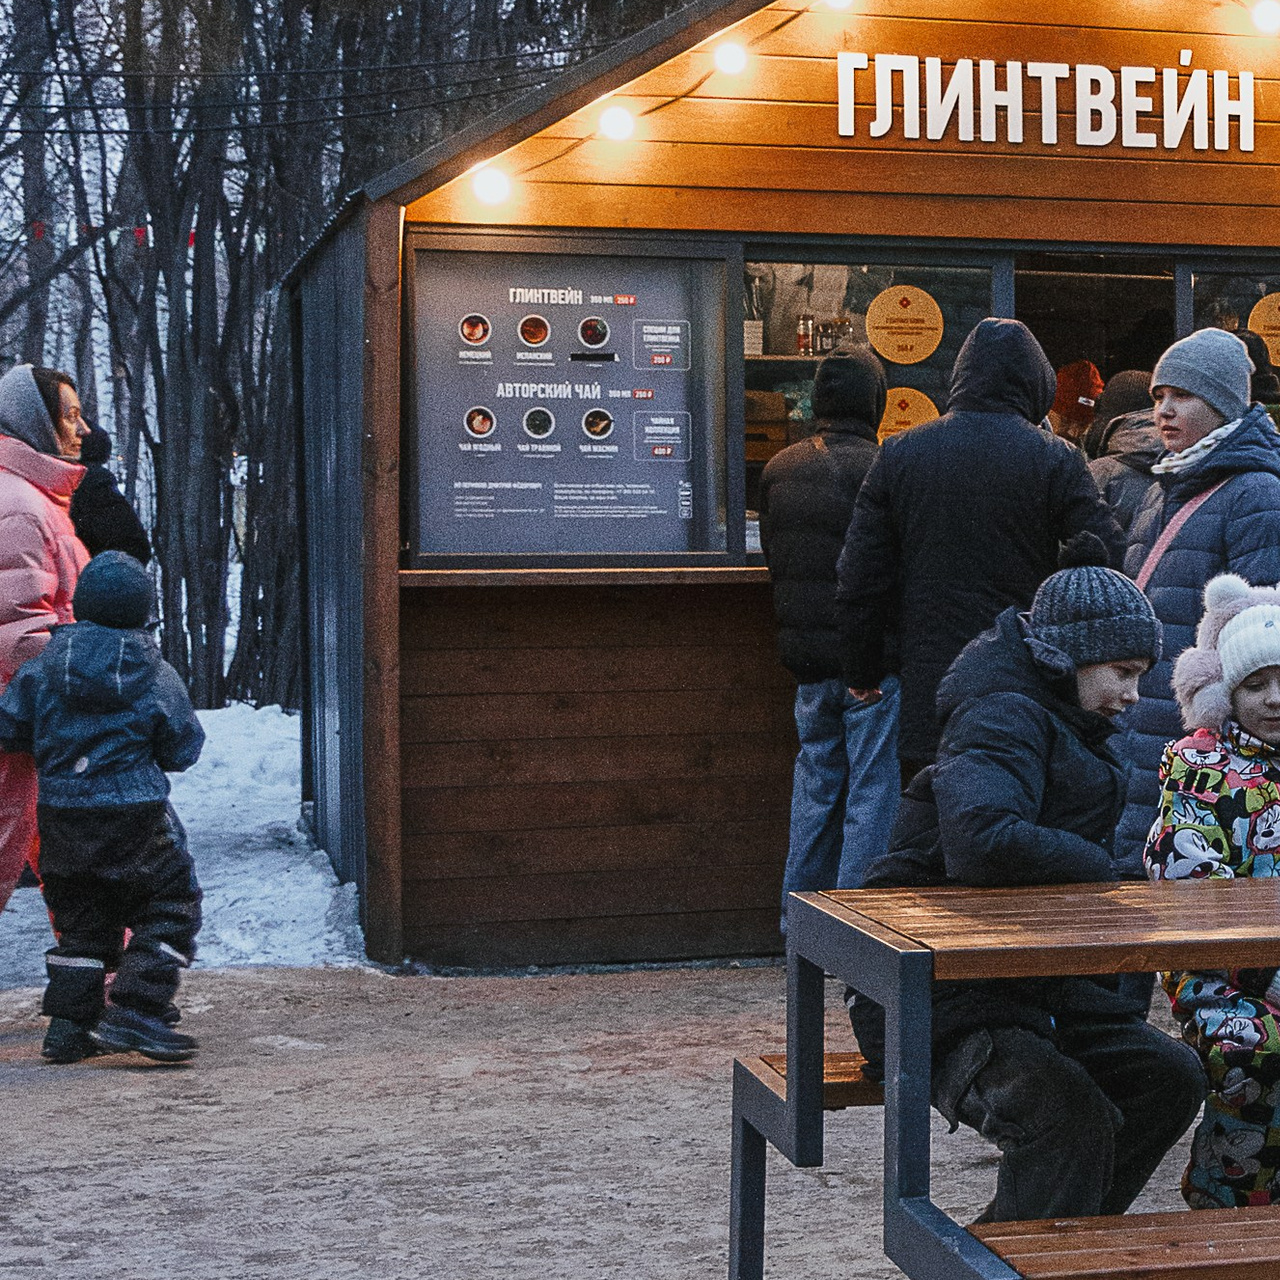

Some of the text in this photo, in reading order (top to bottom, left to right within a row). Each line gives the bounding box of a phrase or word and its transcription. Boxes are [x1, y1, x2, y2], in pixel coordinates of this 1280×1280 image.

[837, 50, 1255, 152] ГЛИНТВЕЙН
[508, 286, 583, 305] ГЛИНТВЕЙН
[496, 381, 572, 399] АВТОРСКИЙ
[574, 382, 602, 400] ЧАЙ
